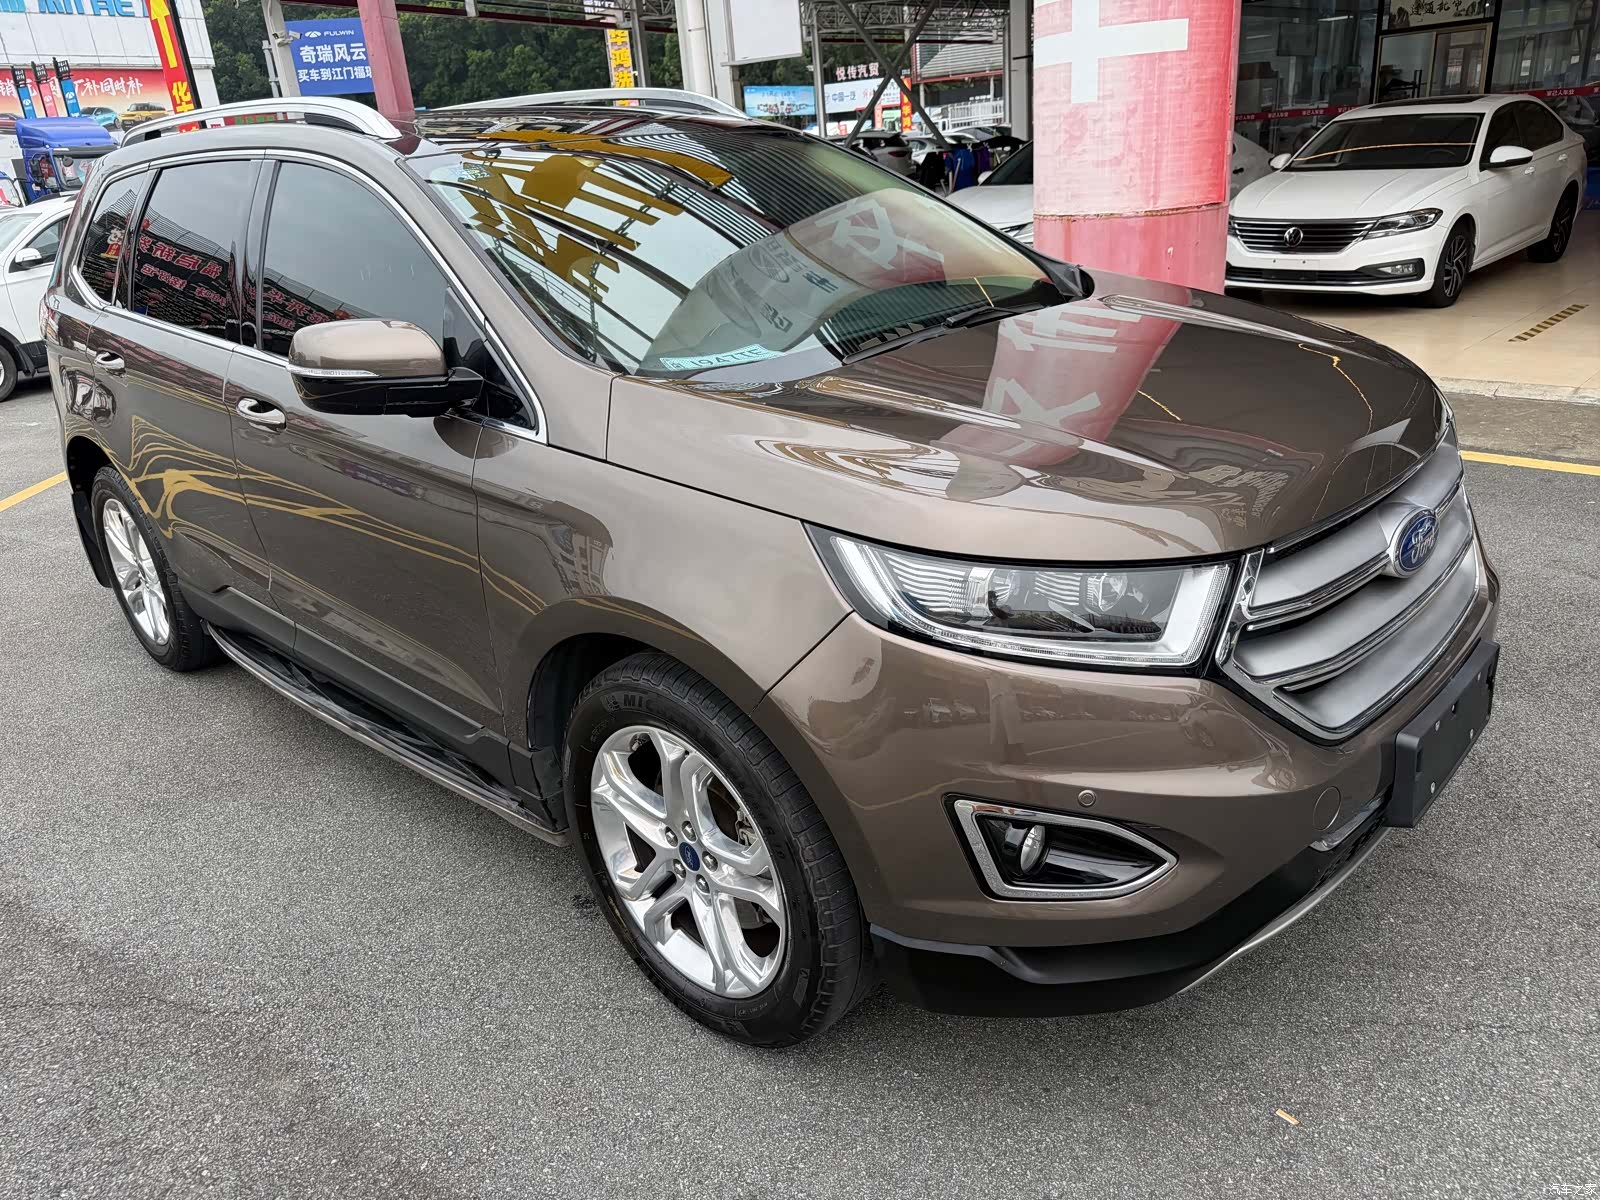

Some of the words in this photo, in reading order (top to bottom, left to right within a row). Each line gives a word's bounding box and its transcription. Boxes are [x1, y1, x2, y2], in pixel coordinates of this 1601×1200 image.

[299, 42, 367, 64] 奇瑞风云
[835, 62, 880, 81] 悦传汽贸
[1408, 517, 1437, 565] Ford
